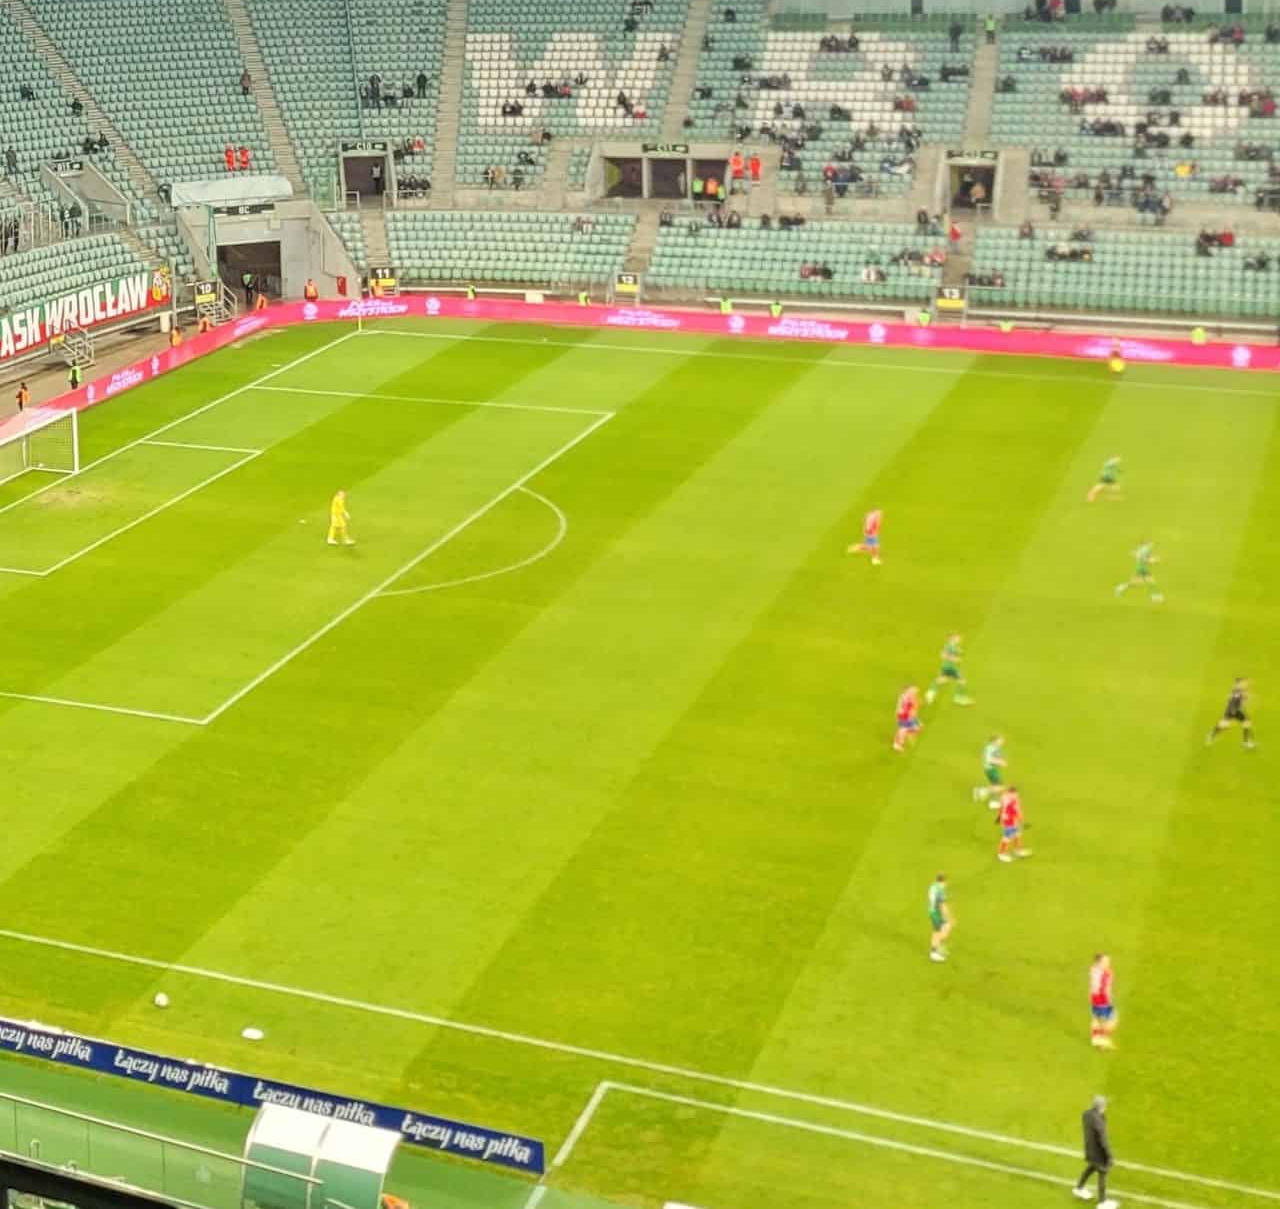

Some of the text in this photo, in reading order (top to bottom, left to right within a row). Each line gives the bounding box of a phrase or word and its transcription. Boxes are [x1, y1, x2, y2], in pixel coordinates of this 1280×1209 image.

[199, 283, 211, 295] 10
[375, 268, 390, 279] 11
[44, 271, 148, 339] WROCŁAW
[27, 1033, 54, 1051] nas
[52, 1036, 92, 1062] piłka
[113, 1048, 230, 1095] Łączy nas piłka
[252, 1080, 376, 1127] Łączy nas piłka
[401, 1113, 532, 1164] Łączy nas piłka
